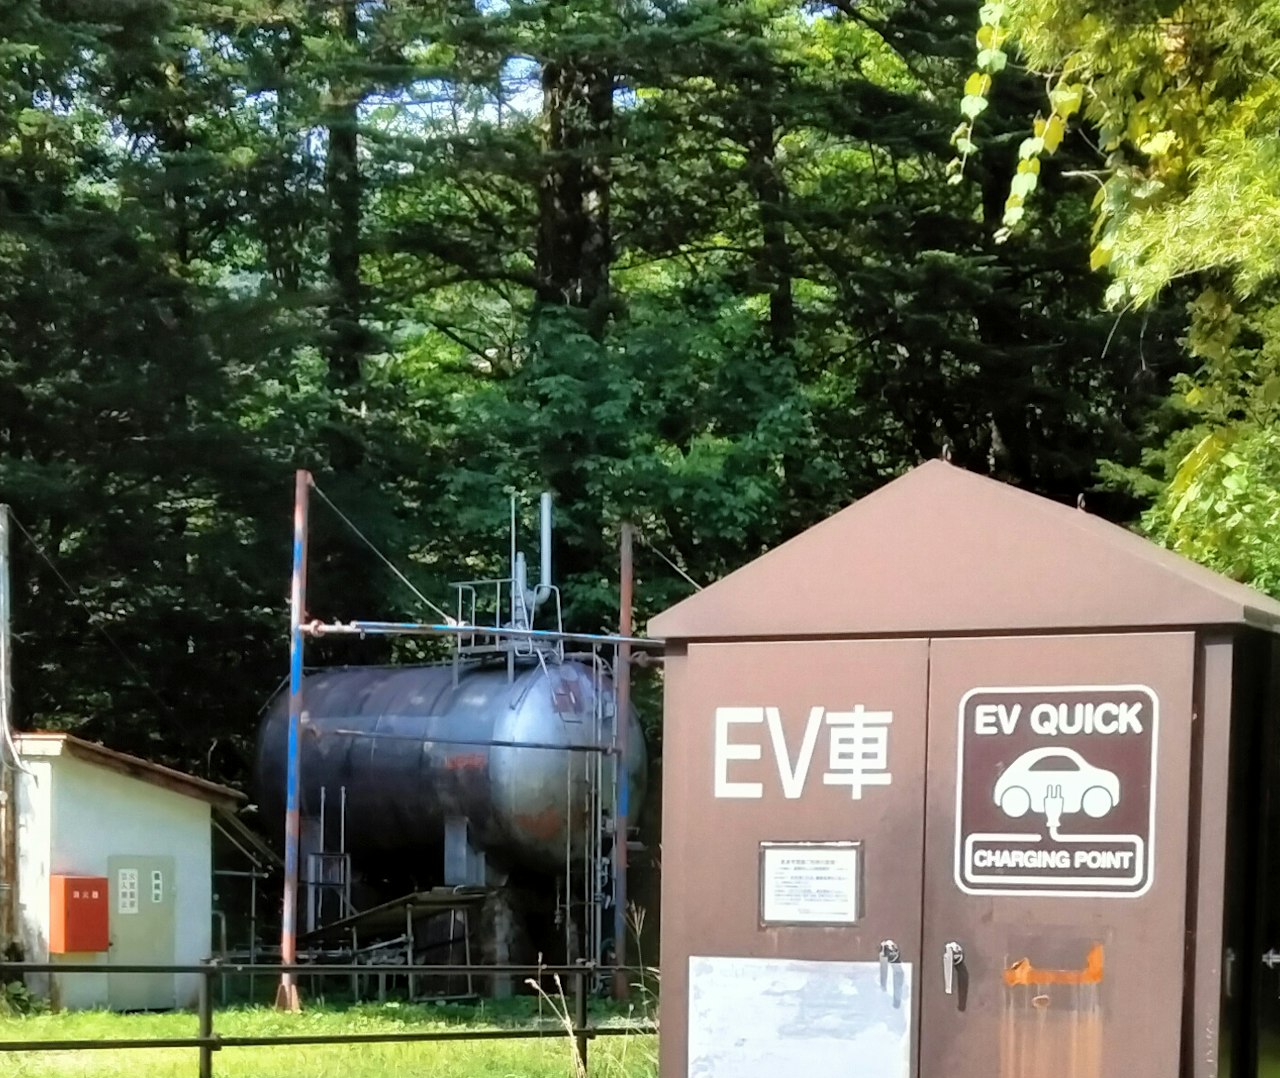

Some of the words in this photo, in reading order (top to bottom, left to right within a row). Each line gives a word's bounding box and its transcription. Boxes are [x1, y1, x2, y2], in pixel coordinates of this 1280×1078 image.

[974, 703, 1021, 735] EV
[1030, 702, 1144, 736] QUICK
[714, 703, 894, 800] EV車
[973, 849, 1071, 869] CHARGING
[1074, 850, 1134, 869] POINT
